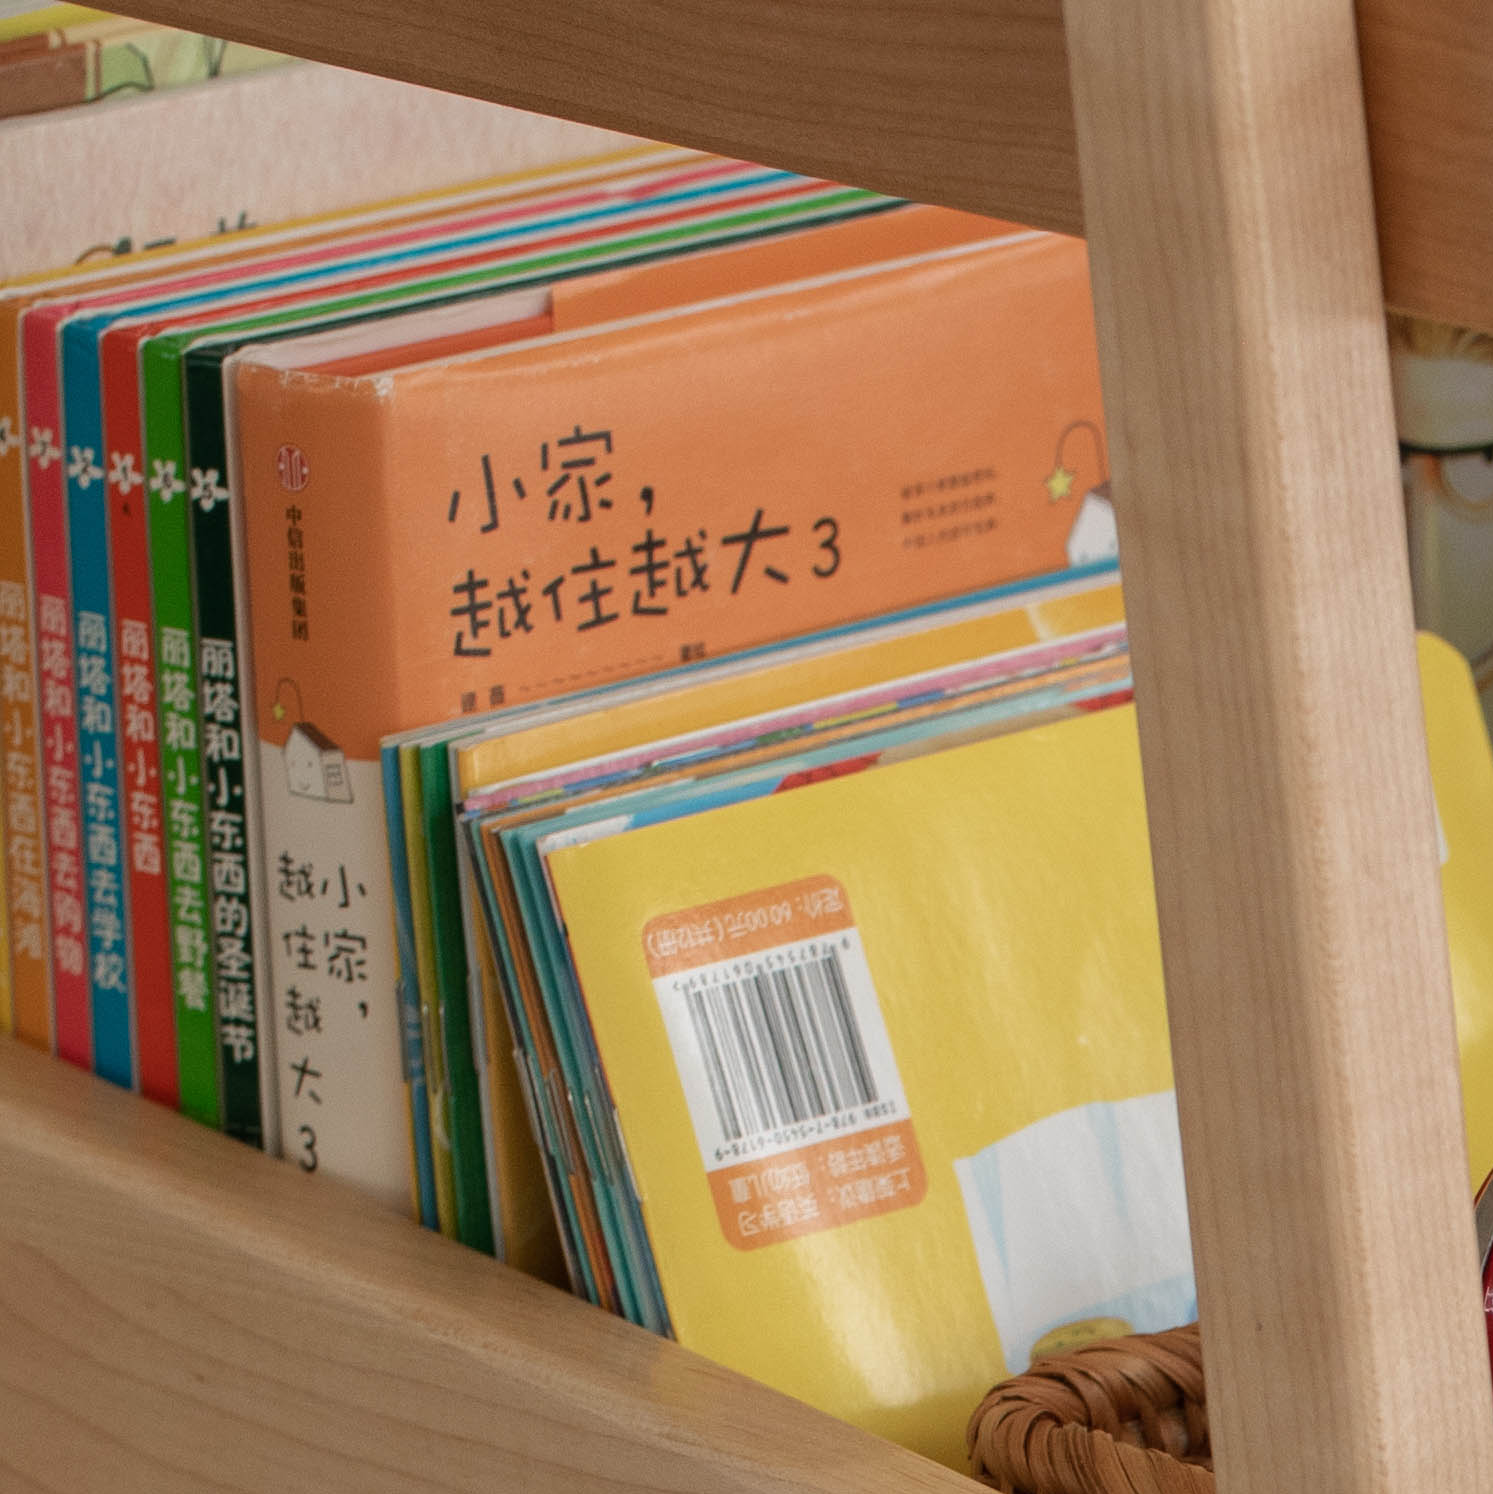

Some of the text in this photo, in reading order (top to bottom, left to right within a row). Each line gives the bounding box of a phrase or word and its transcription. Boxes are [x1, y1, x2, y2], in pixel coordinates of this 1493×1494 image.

[449, 508, 842, 658] 越住越大3
[77, 610, 128, 995] 丽塔和小东西去学校
[119, 618, 162, 876] 丽塔和小东西
[200, 638, 256, 1064] 丽塔和小东西的圣诞节
[276, 850, 324, 1174] 越住越大3
